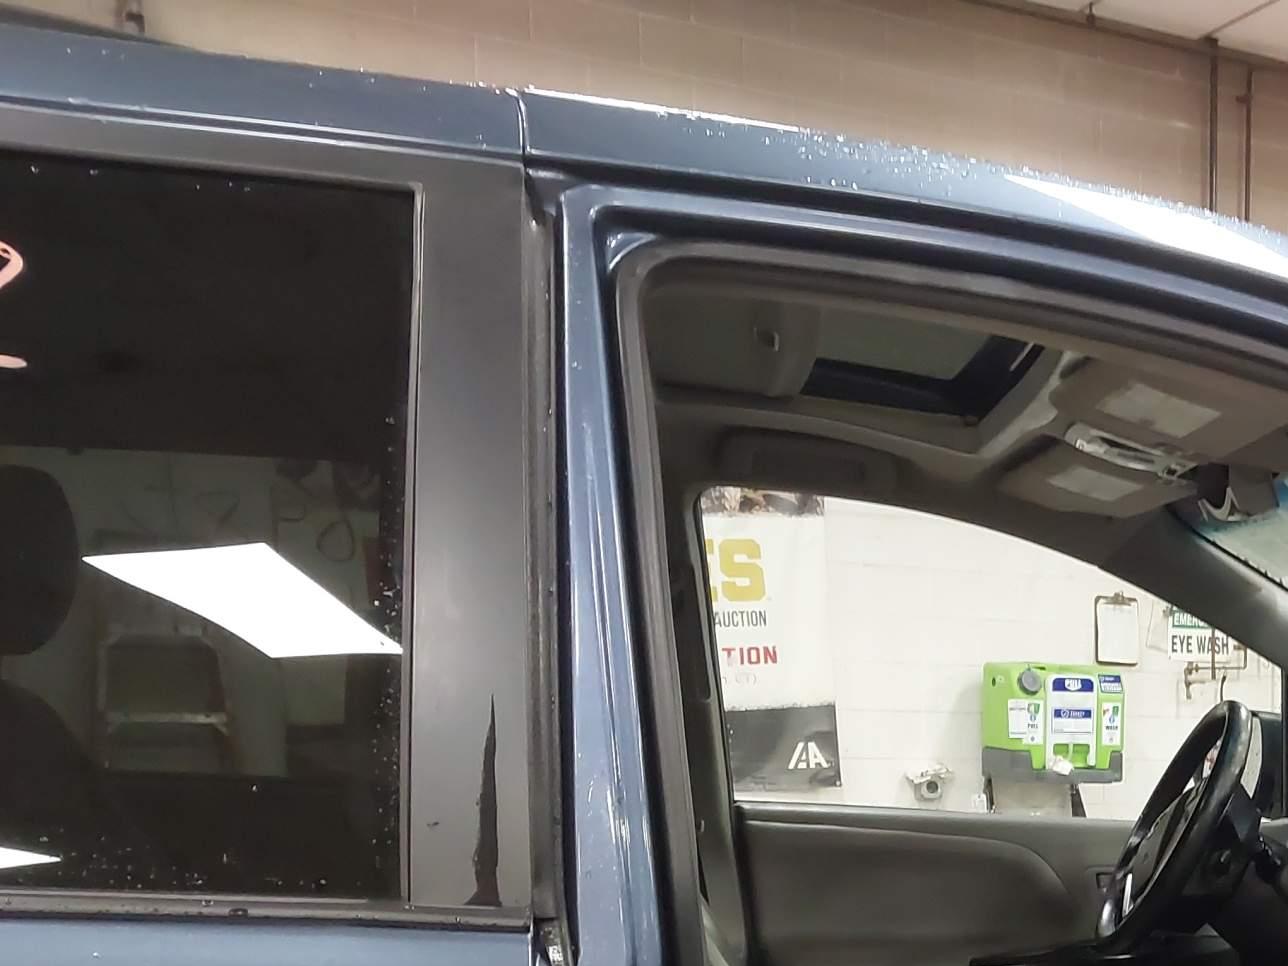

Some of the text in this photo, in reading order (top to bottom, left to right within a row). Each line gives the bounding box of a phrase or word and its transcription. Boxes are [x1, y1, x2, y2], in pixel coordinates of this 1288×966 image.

[705, 538, 767, 602] S
[714, 610, 767, 628] AUCTION
[1171, 635, 1229, 655] EYE WASH
